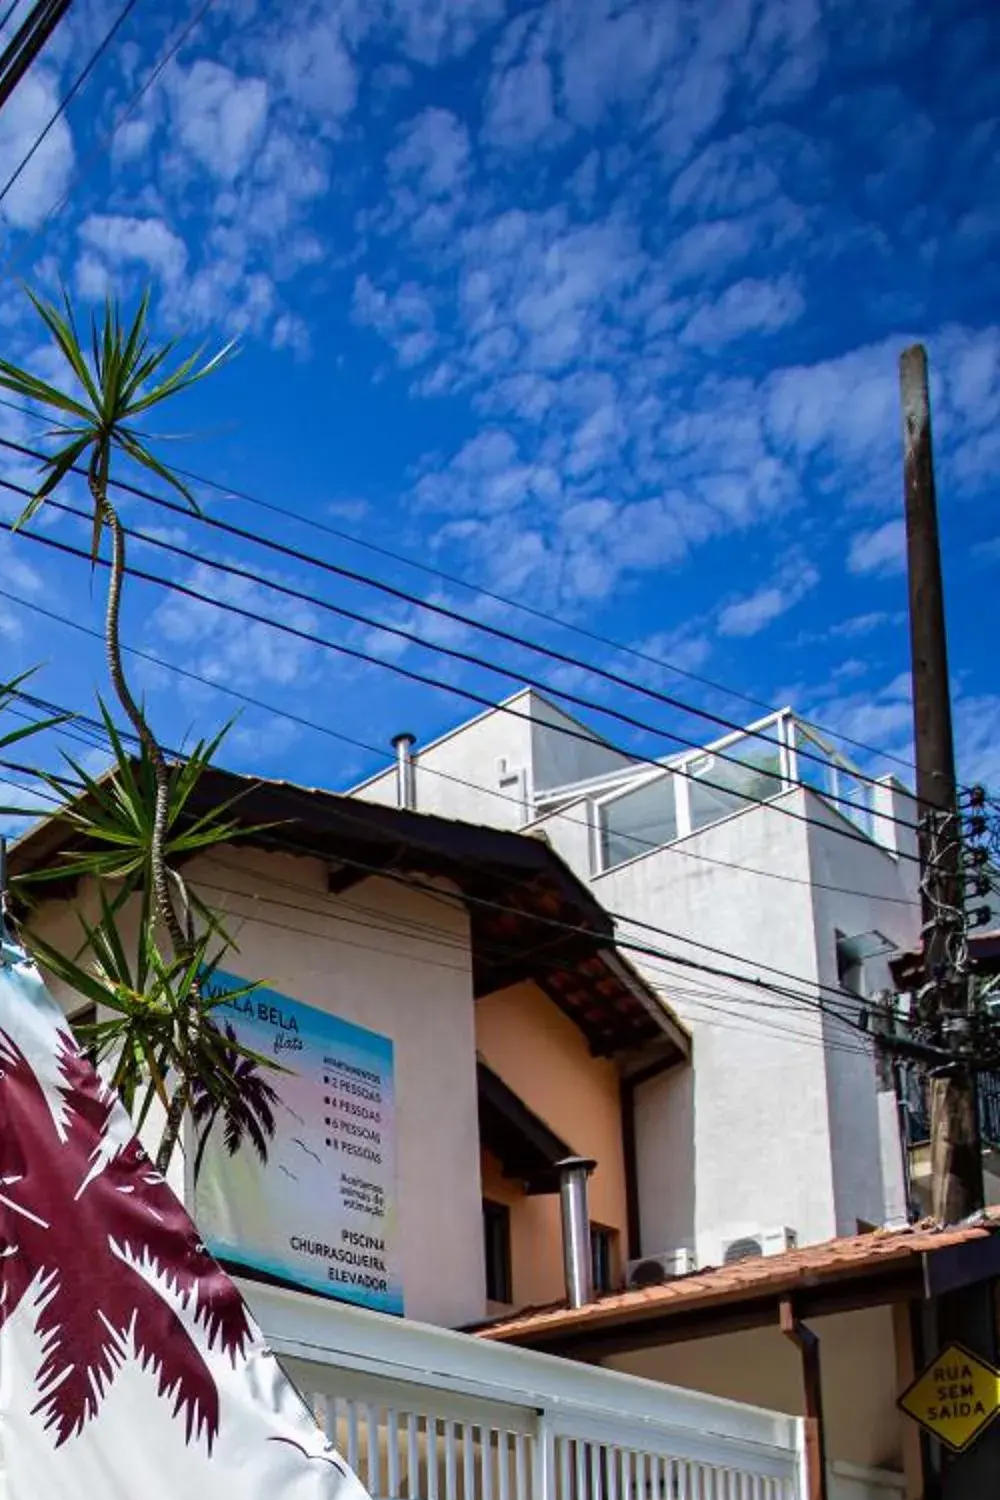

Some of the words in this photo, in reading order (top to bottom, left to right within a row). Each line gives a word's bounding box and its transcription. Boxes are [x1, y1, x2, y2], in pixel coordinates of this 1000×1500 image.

[257, 1003, 299, 1034] BELA
[273, 1031, 303, 1055] flats
[339, 1080, 382, 1104] PESSOAS
[339, 1099, 382, 1124] PESSOAS
[340, 1120, 382, 1145] PESSOAS
[341, 1141, 383, 1165] PESSOAS
[341, 1229, 385, 1252] PISCINA
[290, 1236, 387, 1273] CHURRASQUEIRA
[327, 1266, 388, 1292] ELEVADOR
[933, 1364, 973, 1382] RUA
[936, 1383, 975, 1402] SEM
